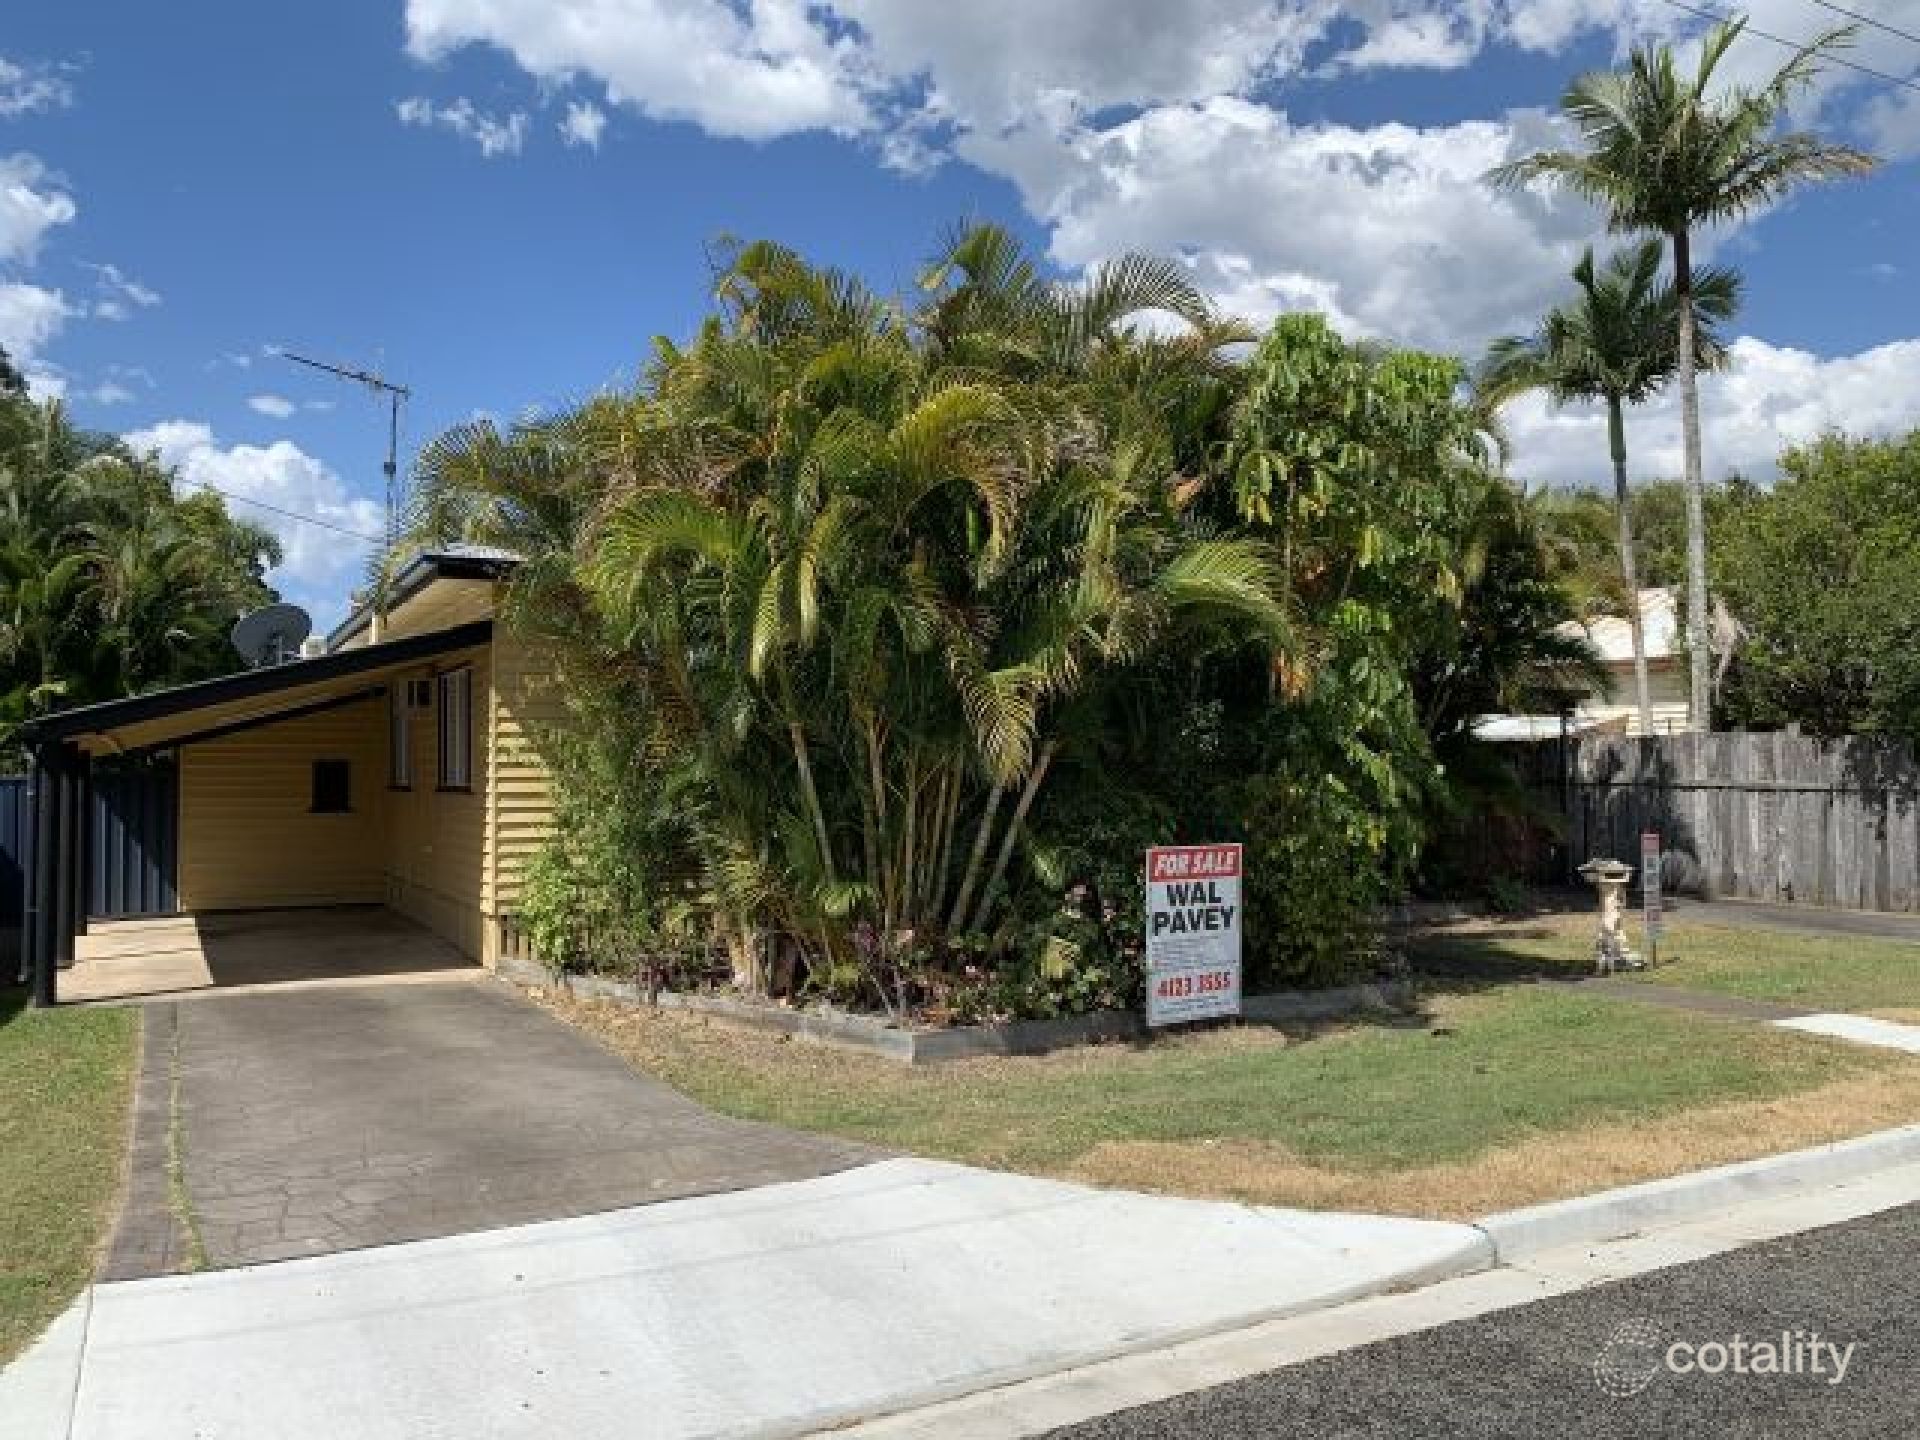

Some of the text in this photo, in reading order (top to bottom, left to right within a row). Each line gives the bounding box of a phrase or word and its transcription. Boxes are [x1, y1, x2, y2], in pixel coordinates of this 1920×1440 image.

[1154, 850, 1238, 877] FOR SALE
[1166, 881, 1222, 906] WAL
[1153, 905, 1234, 936] PAVEY
